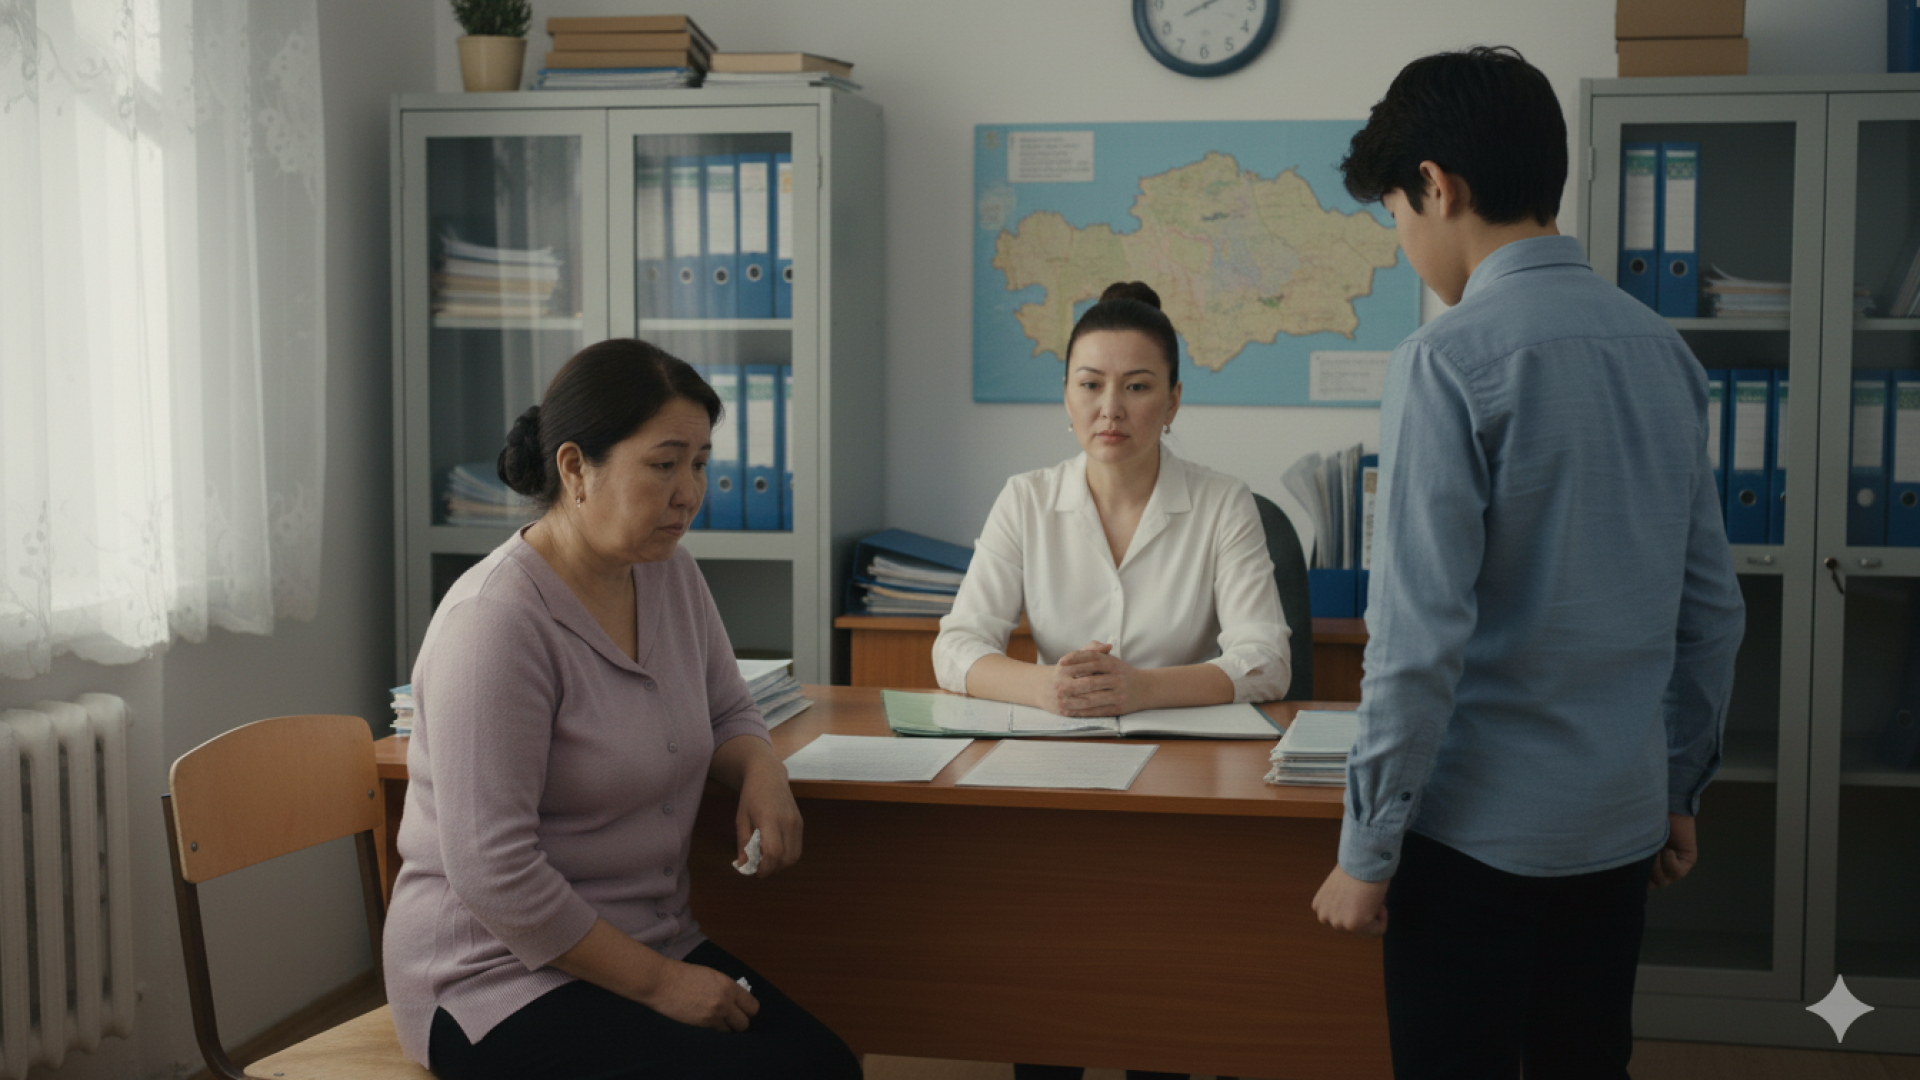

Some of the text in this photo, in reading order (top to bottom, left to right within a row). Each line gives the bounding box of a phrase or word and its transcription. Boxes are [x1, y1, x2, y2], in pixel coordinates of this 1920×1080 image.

[1240, 18, 1249, 33] 4
[1176, 37, 1186, 54] 7
[1199, 43, 1210, 59] 6
[1224, 36, 1234, 52] 5
